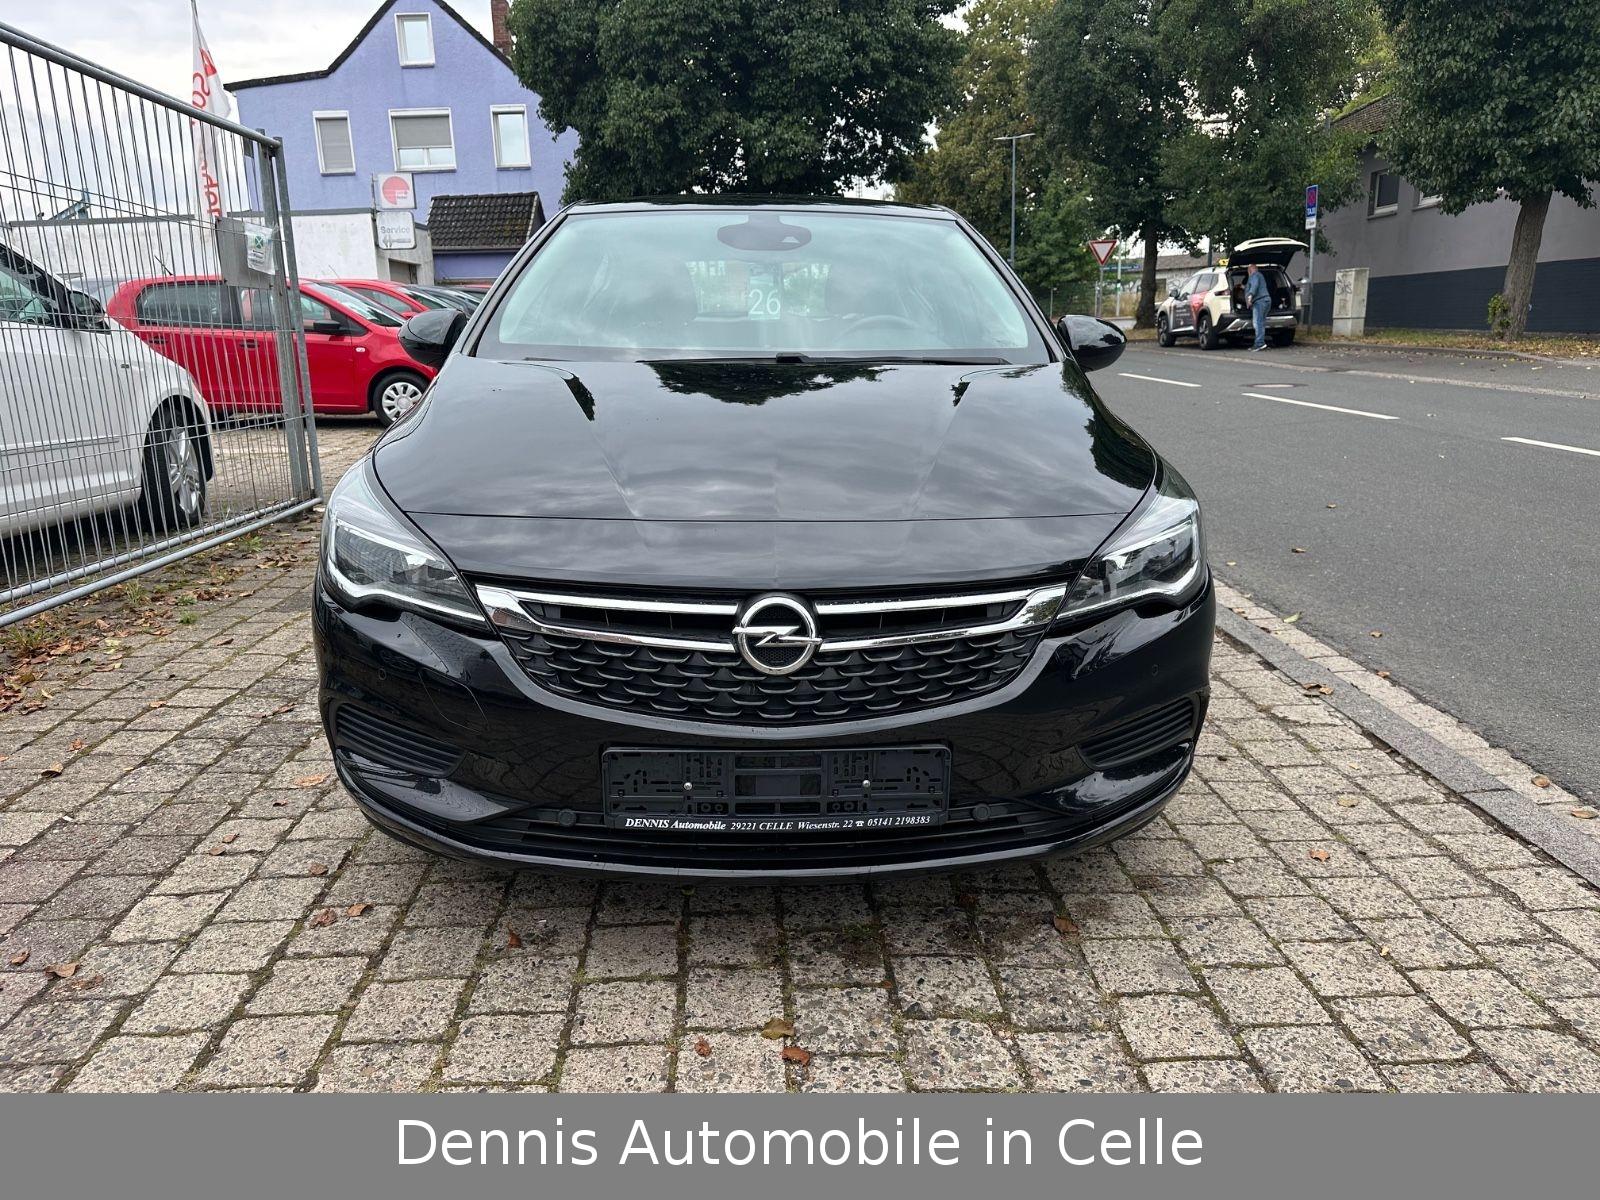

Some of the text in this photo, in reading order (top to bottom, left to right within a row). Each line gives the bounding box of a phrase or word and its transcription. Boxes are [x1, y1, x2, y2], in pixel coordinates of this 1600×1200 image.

[381, 226, 410, 234] Service
[749, 289, 781, 315] 26
[624, 815, 931, 831] DENNIS Automobile 29221 CELLE Wiesenstr. 22 05141 2198383
